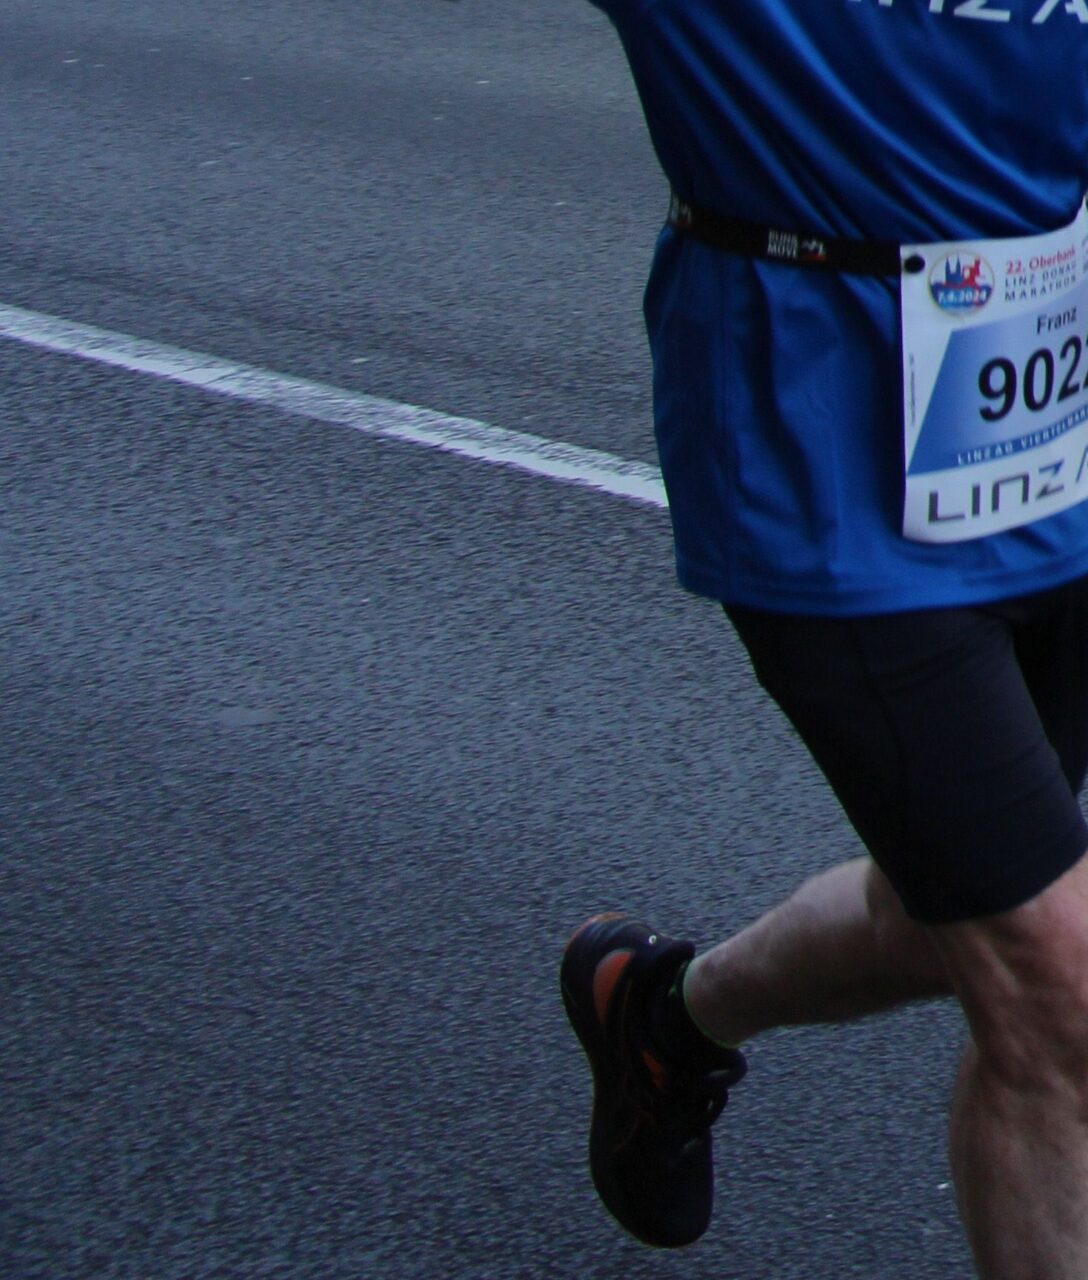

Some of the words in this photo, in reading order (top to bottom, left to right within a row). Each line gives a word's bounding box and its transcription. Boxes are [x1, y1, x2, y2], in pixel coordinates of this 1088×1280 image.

[1006, 260, 1026, 275] 22.
[1029, 244, 1076, 271] Oberbank
[1005, 272, 1036, 288] LINZ
[1005, 274, 1077, 301] MARATHON
[1037, 306, 1077, 334] Franz
[928, 459, 1065, 524] LINZ
